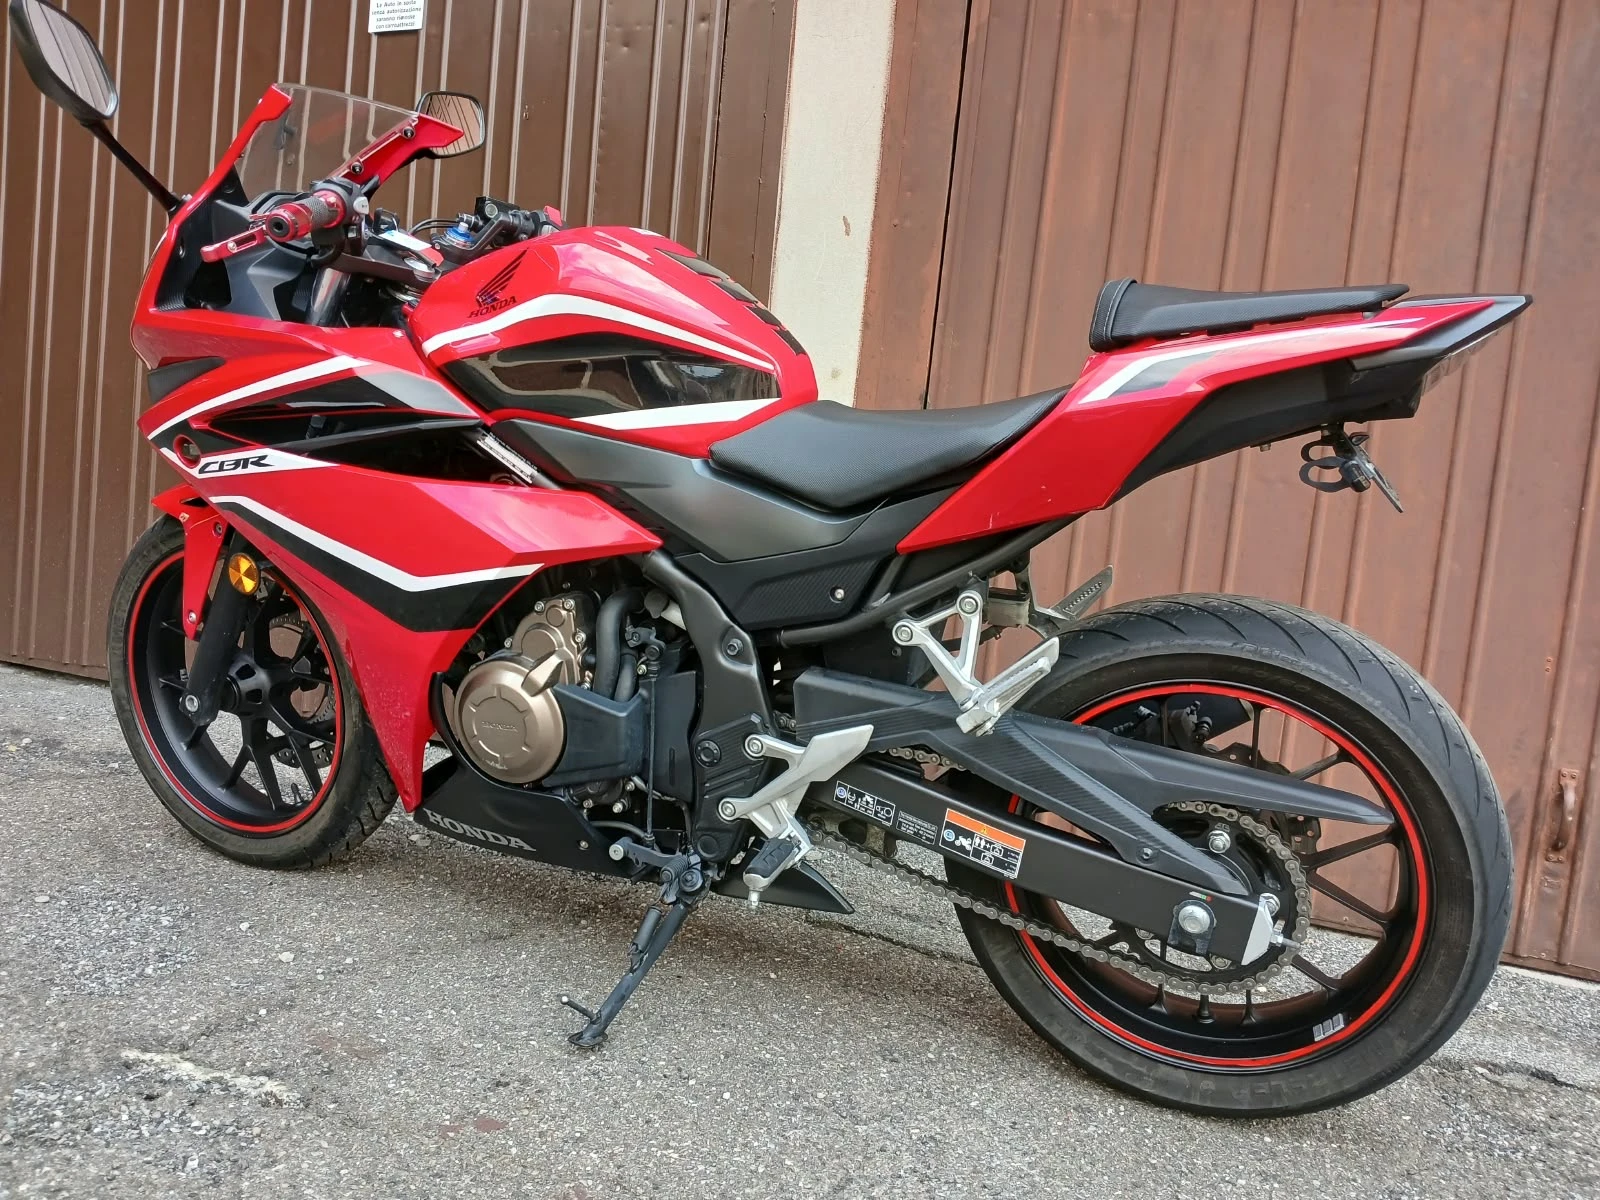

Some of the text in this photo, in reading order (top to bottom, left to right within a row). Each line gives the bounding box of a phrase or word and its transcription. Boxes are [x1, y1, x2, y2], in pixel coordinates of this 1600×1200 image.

[467, 296, 517, 318] HONDA
[198, 455, 275, 474] CBR
[422, 807, 537, 852] HONDA
